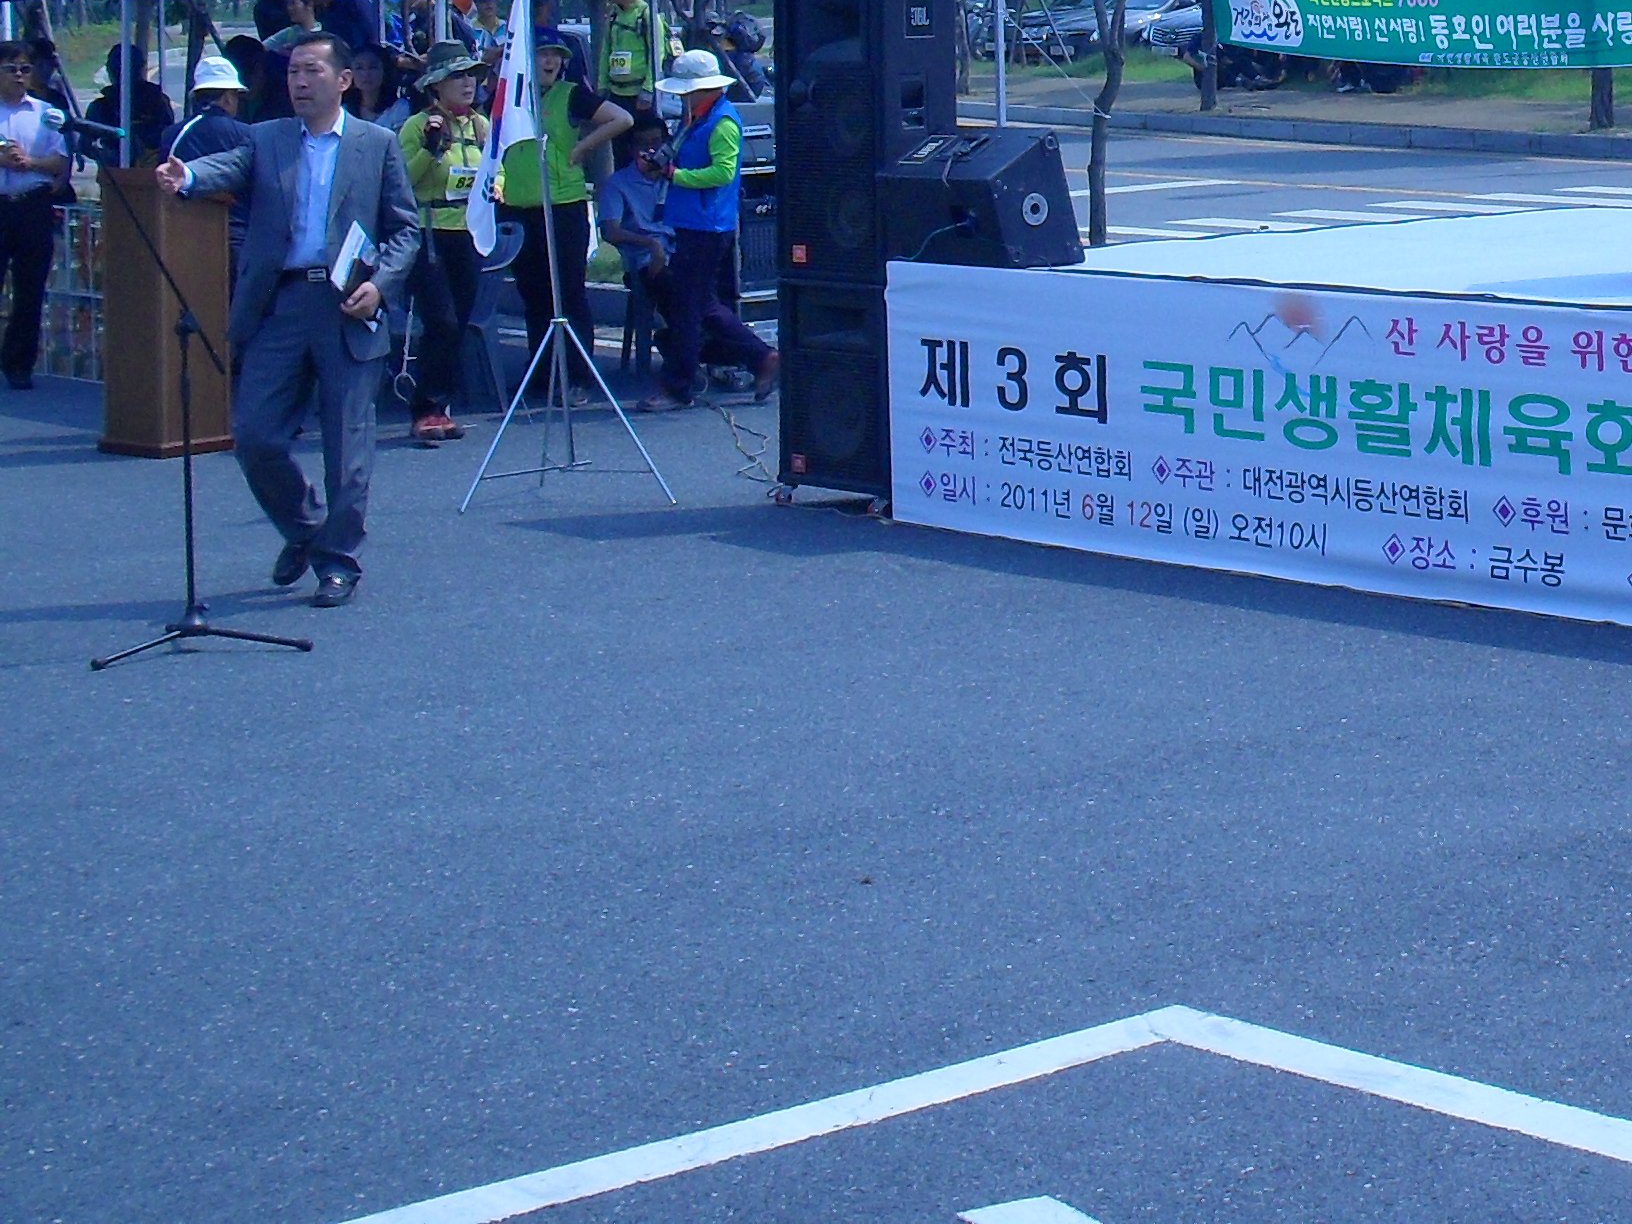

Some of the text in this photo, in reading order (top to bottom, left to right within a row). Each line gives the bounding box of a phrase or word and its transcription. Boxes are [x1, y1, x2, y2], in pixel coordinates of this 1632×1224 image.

[911, 6, 930, 26] JBL
[1385, 316, 1418, 358] 산
[1436, 320, 1550, 367] 사랑을
[919, 338, 971, 409] 제
[996, 347, 1028, 412] 3
[1054, 350, 1108, 424] 회
[998, 436, 1132, 482] 전국등산연합회
[1000, 480, 1072, 520] 2011년
[1081, 494, 1115, 527] 6월
[1127, 501, 1173, 535] 12일
[1183, 507, 1220, 541] (일)
[1229, 514, 1328, 556] 오전10시
[1242, 466, 1470, 525] 대전광역시등산연합회
[1488, 545, 1566, 588] 금수봉
